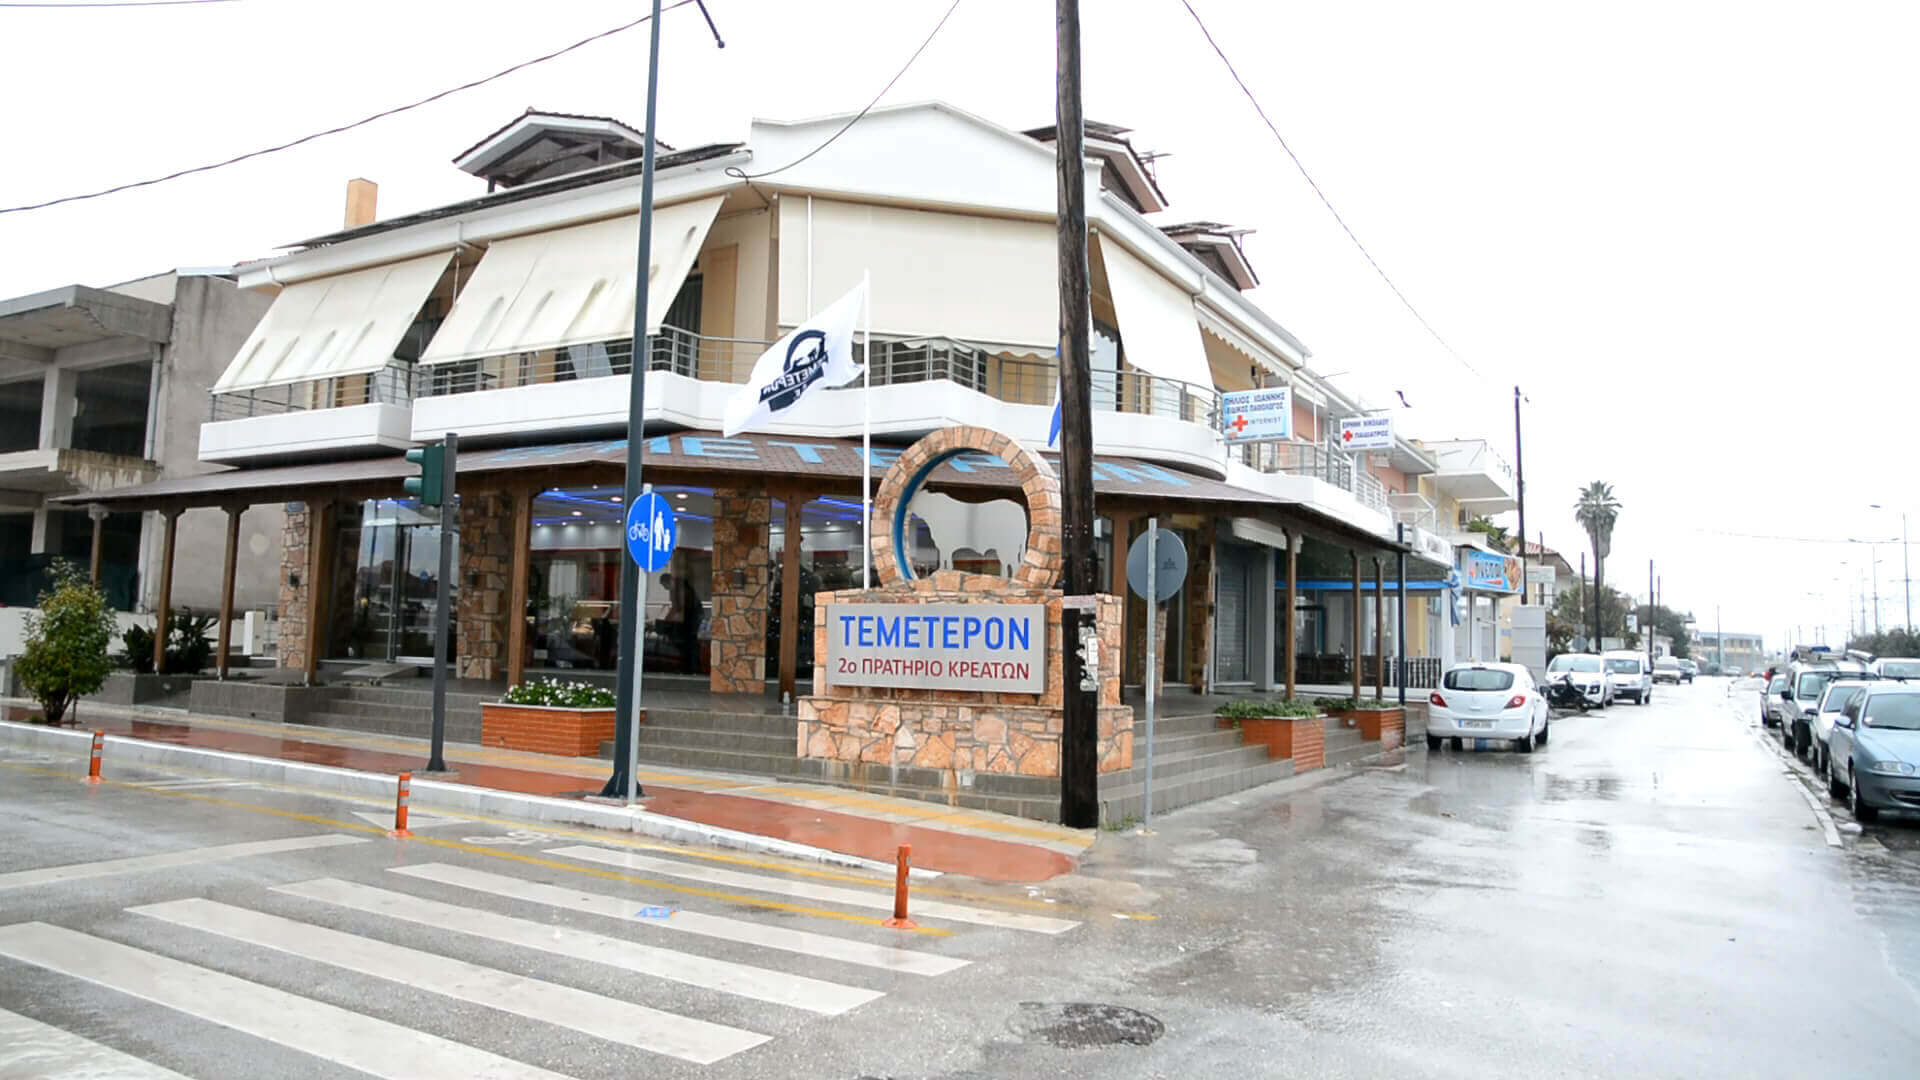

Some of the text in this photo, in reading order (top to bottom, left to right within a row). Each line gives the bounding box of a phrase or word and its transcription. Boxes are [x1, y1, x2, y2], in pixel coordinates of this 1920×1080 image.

[839, 615, 1030, 650] ΤΕΜΕΤΕΡΟΝ
[837, 657, 1030, 681] 2ο ΠΡΑΤΗΡΙΟ ΚΡΕΑΤΩΝ
